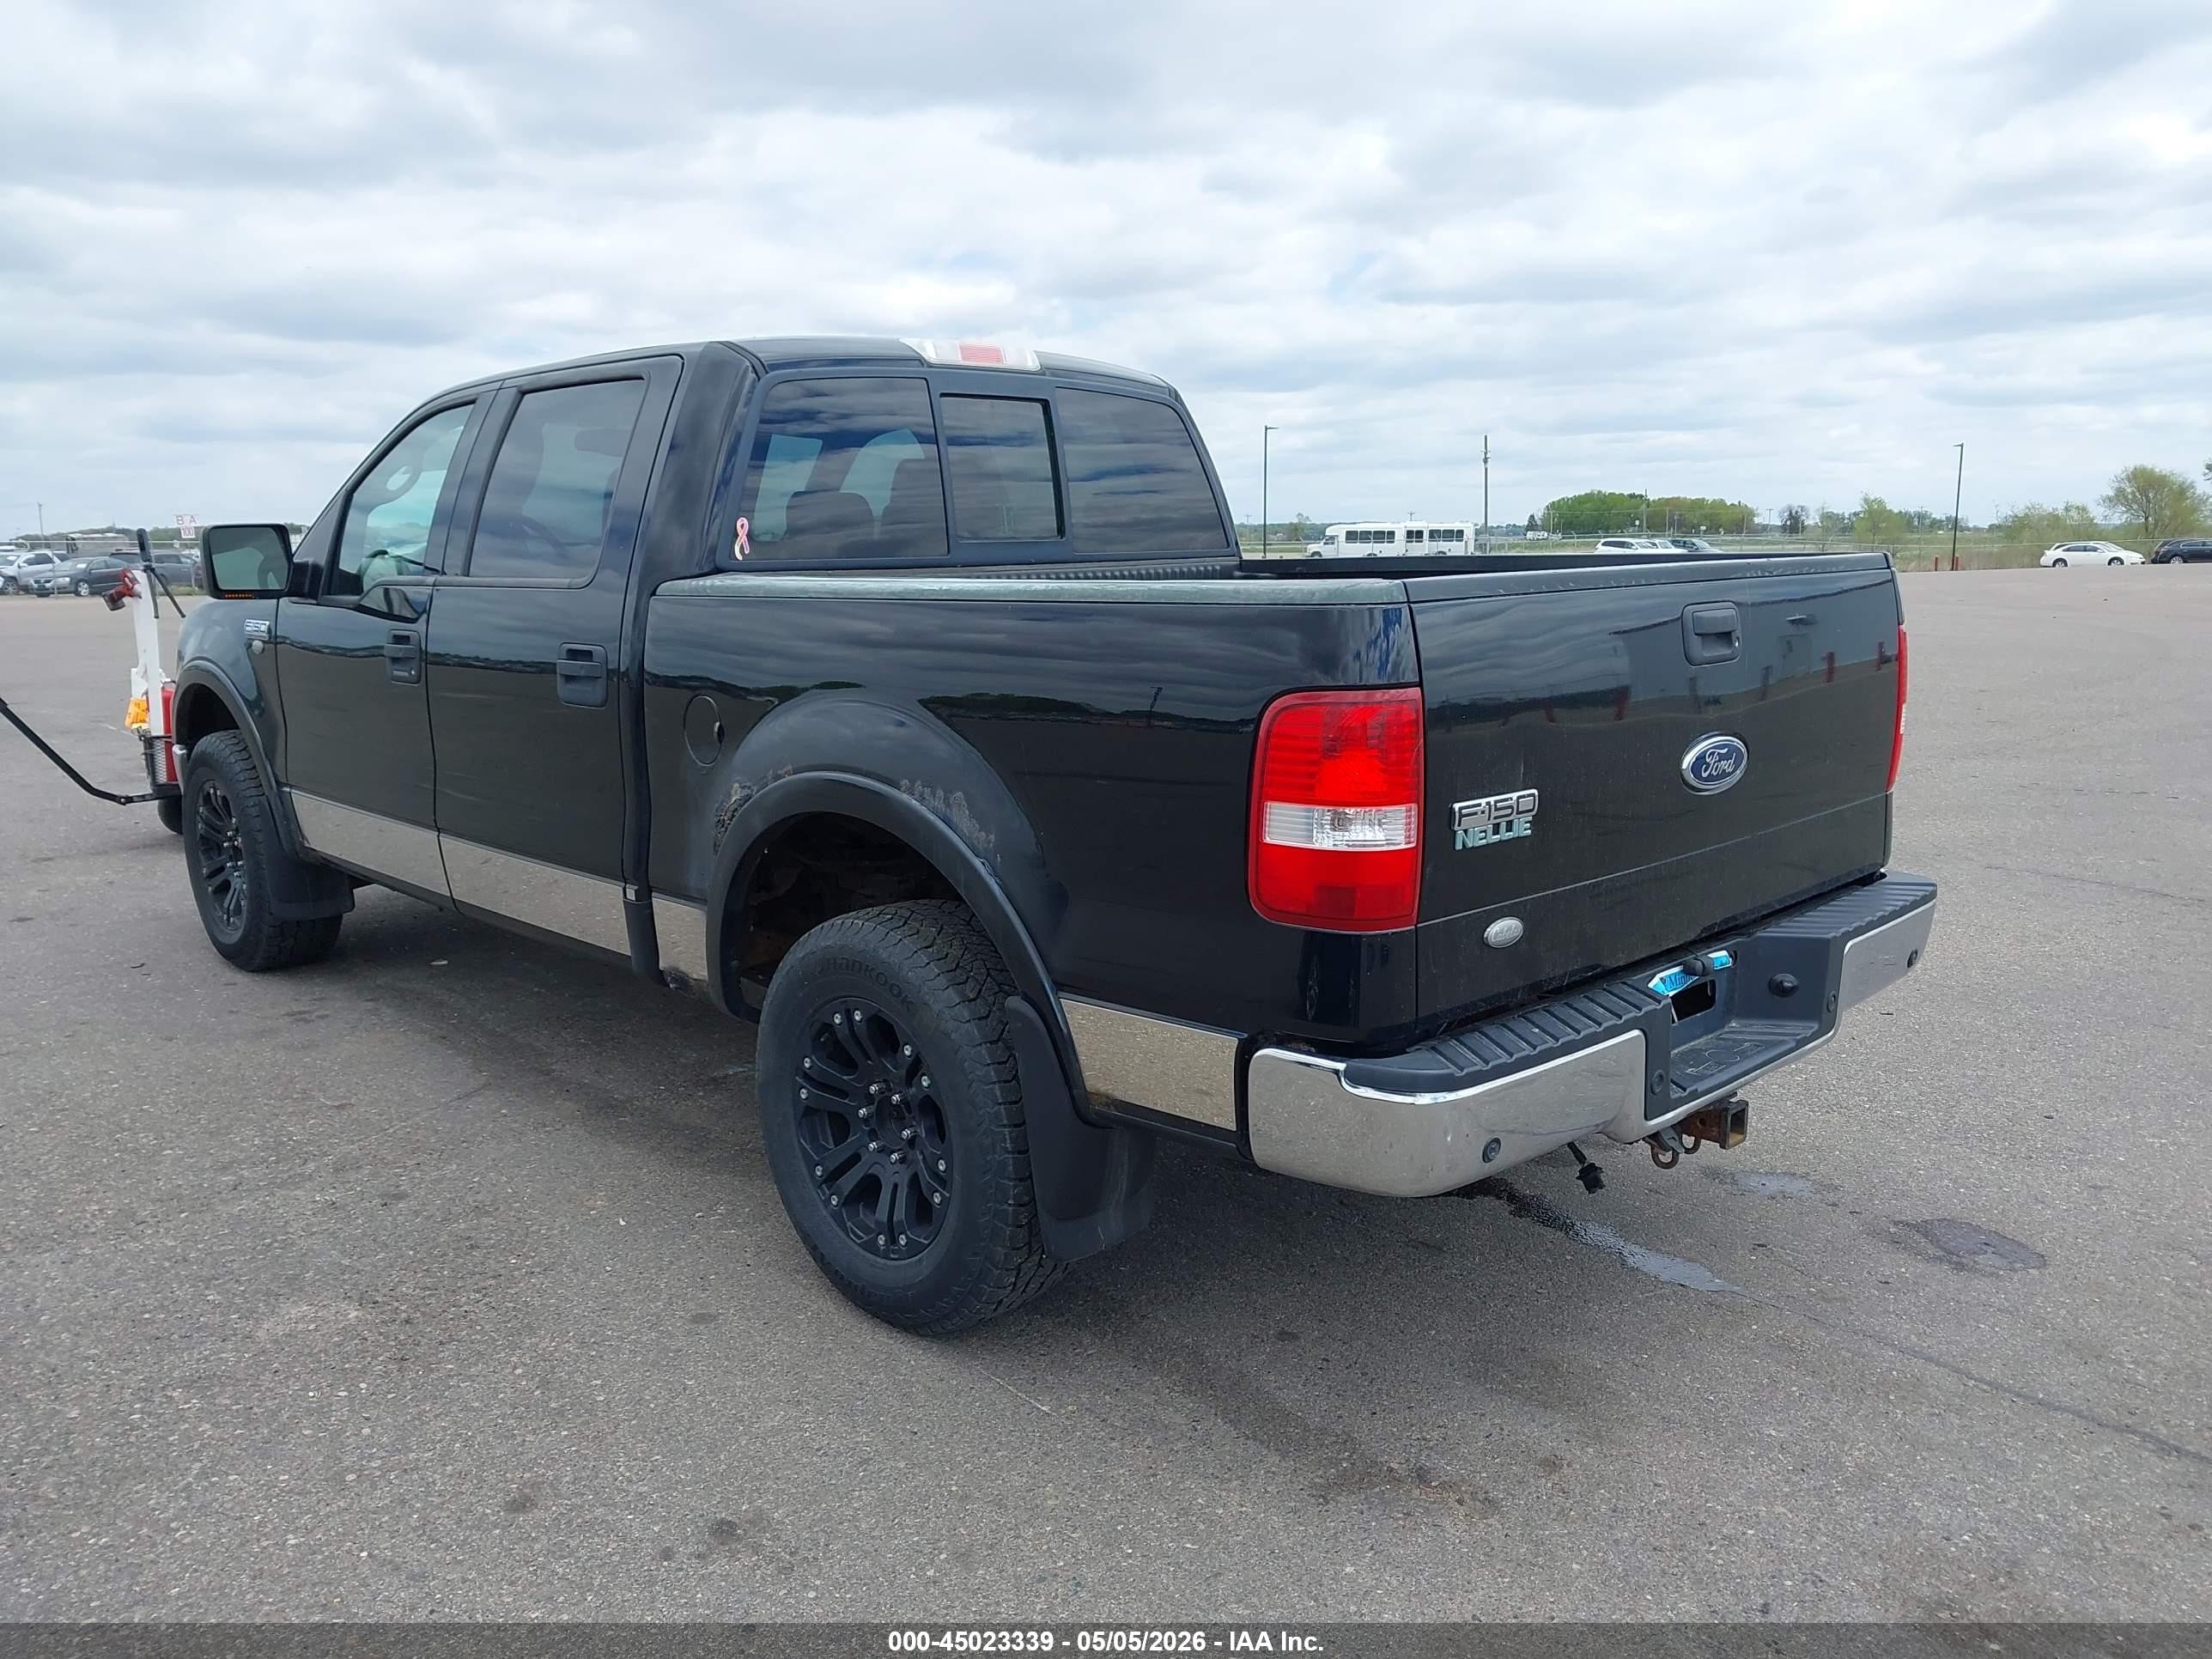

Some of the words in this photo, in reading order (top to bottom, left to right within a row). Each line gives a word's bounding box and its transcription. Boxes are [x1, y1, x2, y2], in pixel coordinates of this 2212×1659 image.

[175, 514, 184, 525] B
[190, 514, 198, 525] A
[1701, 747, 1737, 779] Ford
[1455, 816, 1533, 850] NELLIE
